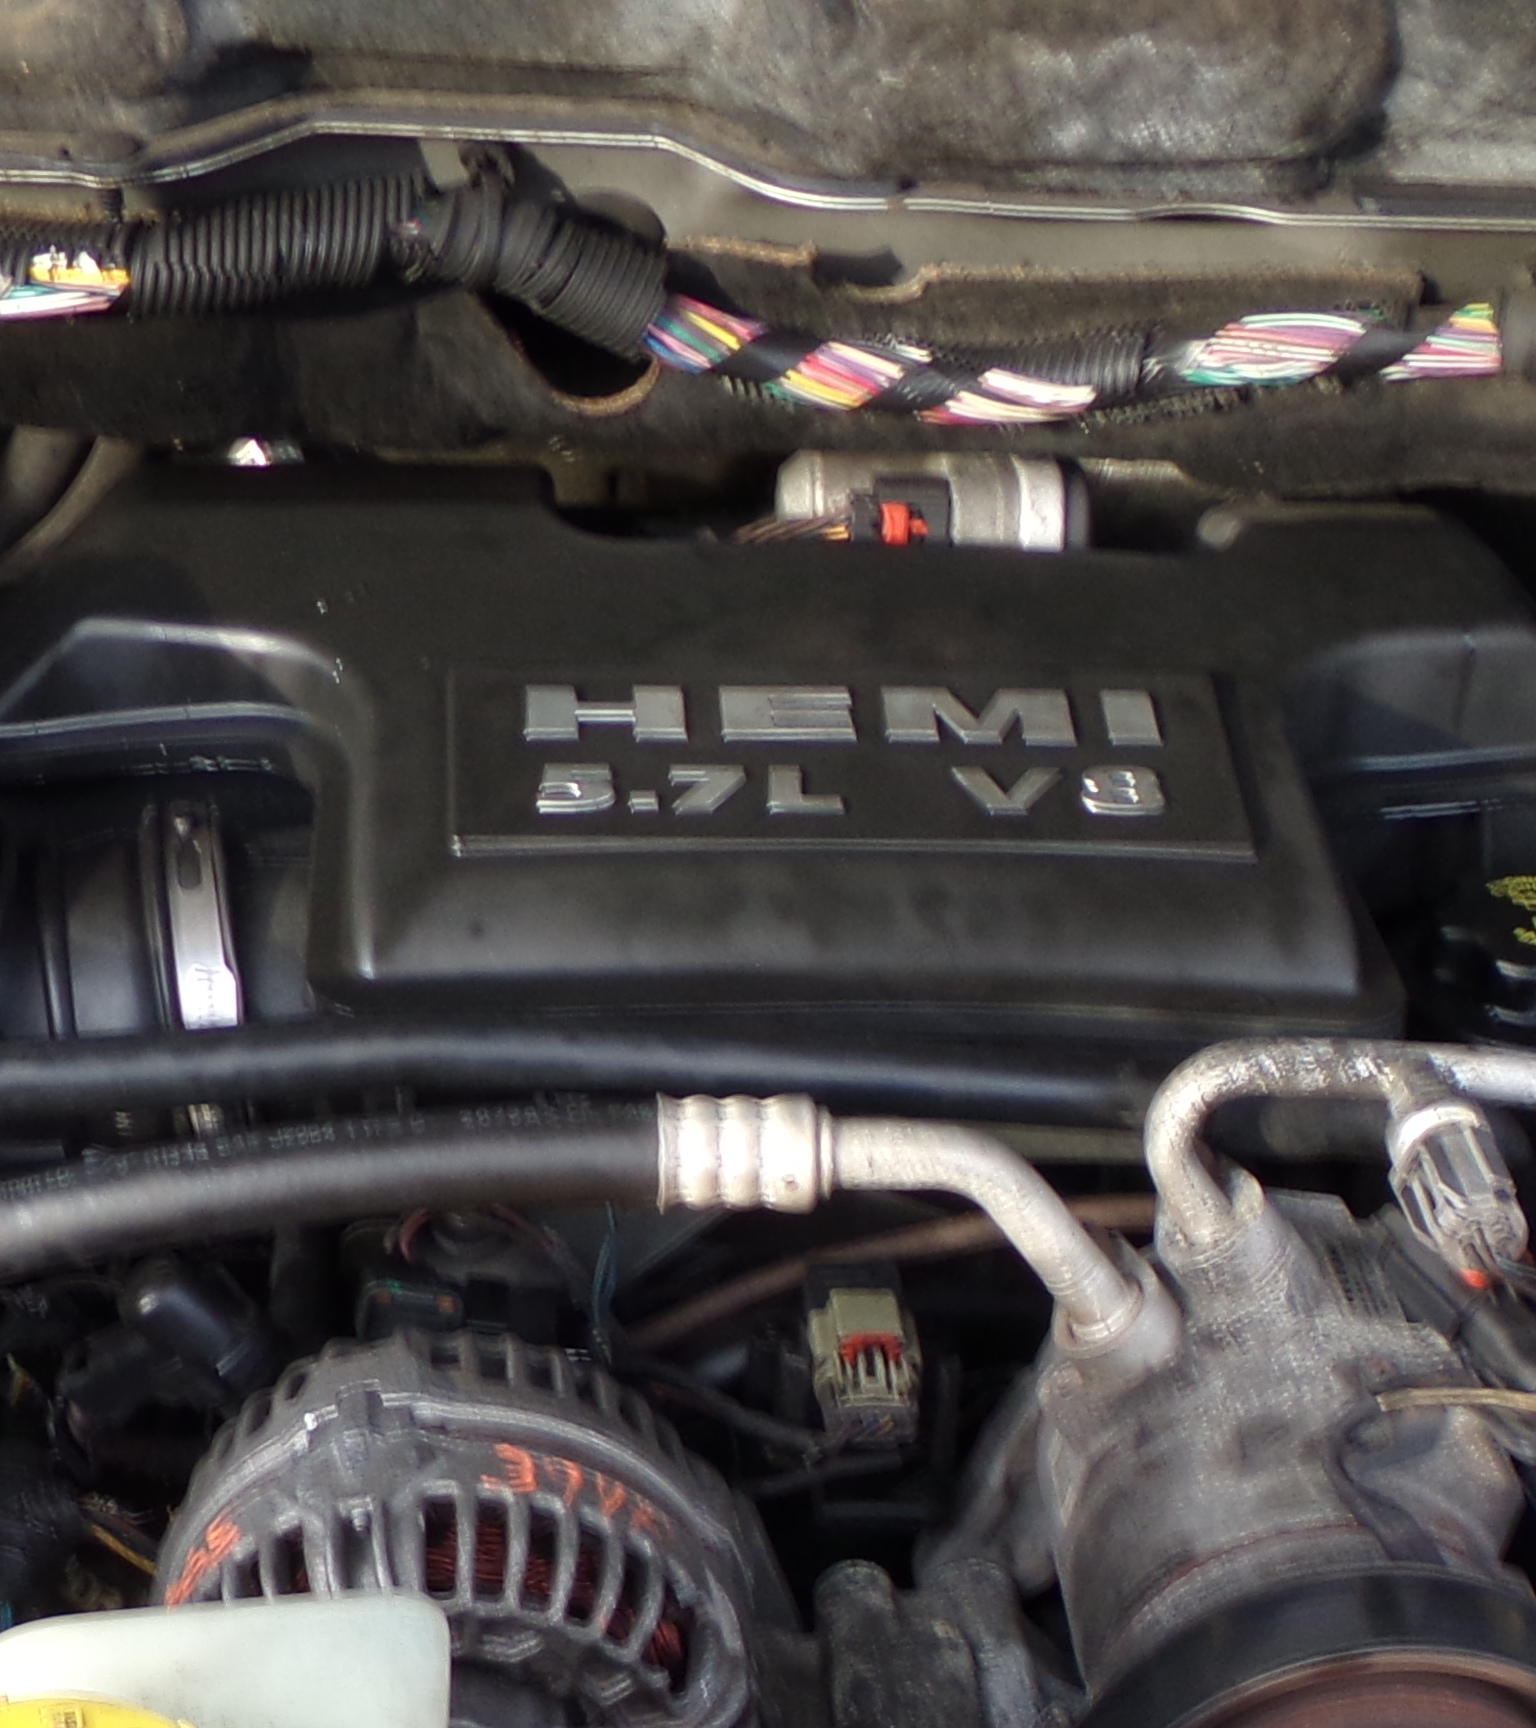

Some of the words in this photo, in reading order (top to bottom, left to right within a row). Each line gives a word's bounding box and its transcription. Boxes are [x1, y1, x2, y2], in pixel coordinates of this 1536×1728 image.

[522, 683, 1164, 747] HEMI
[536, 763, 847, 815] 5.7L
[950, 765, 1167, 816] V8
